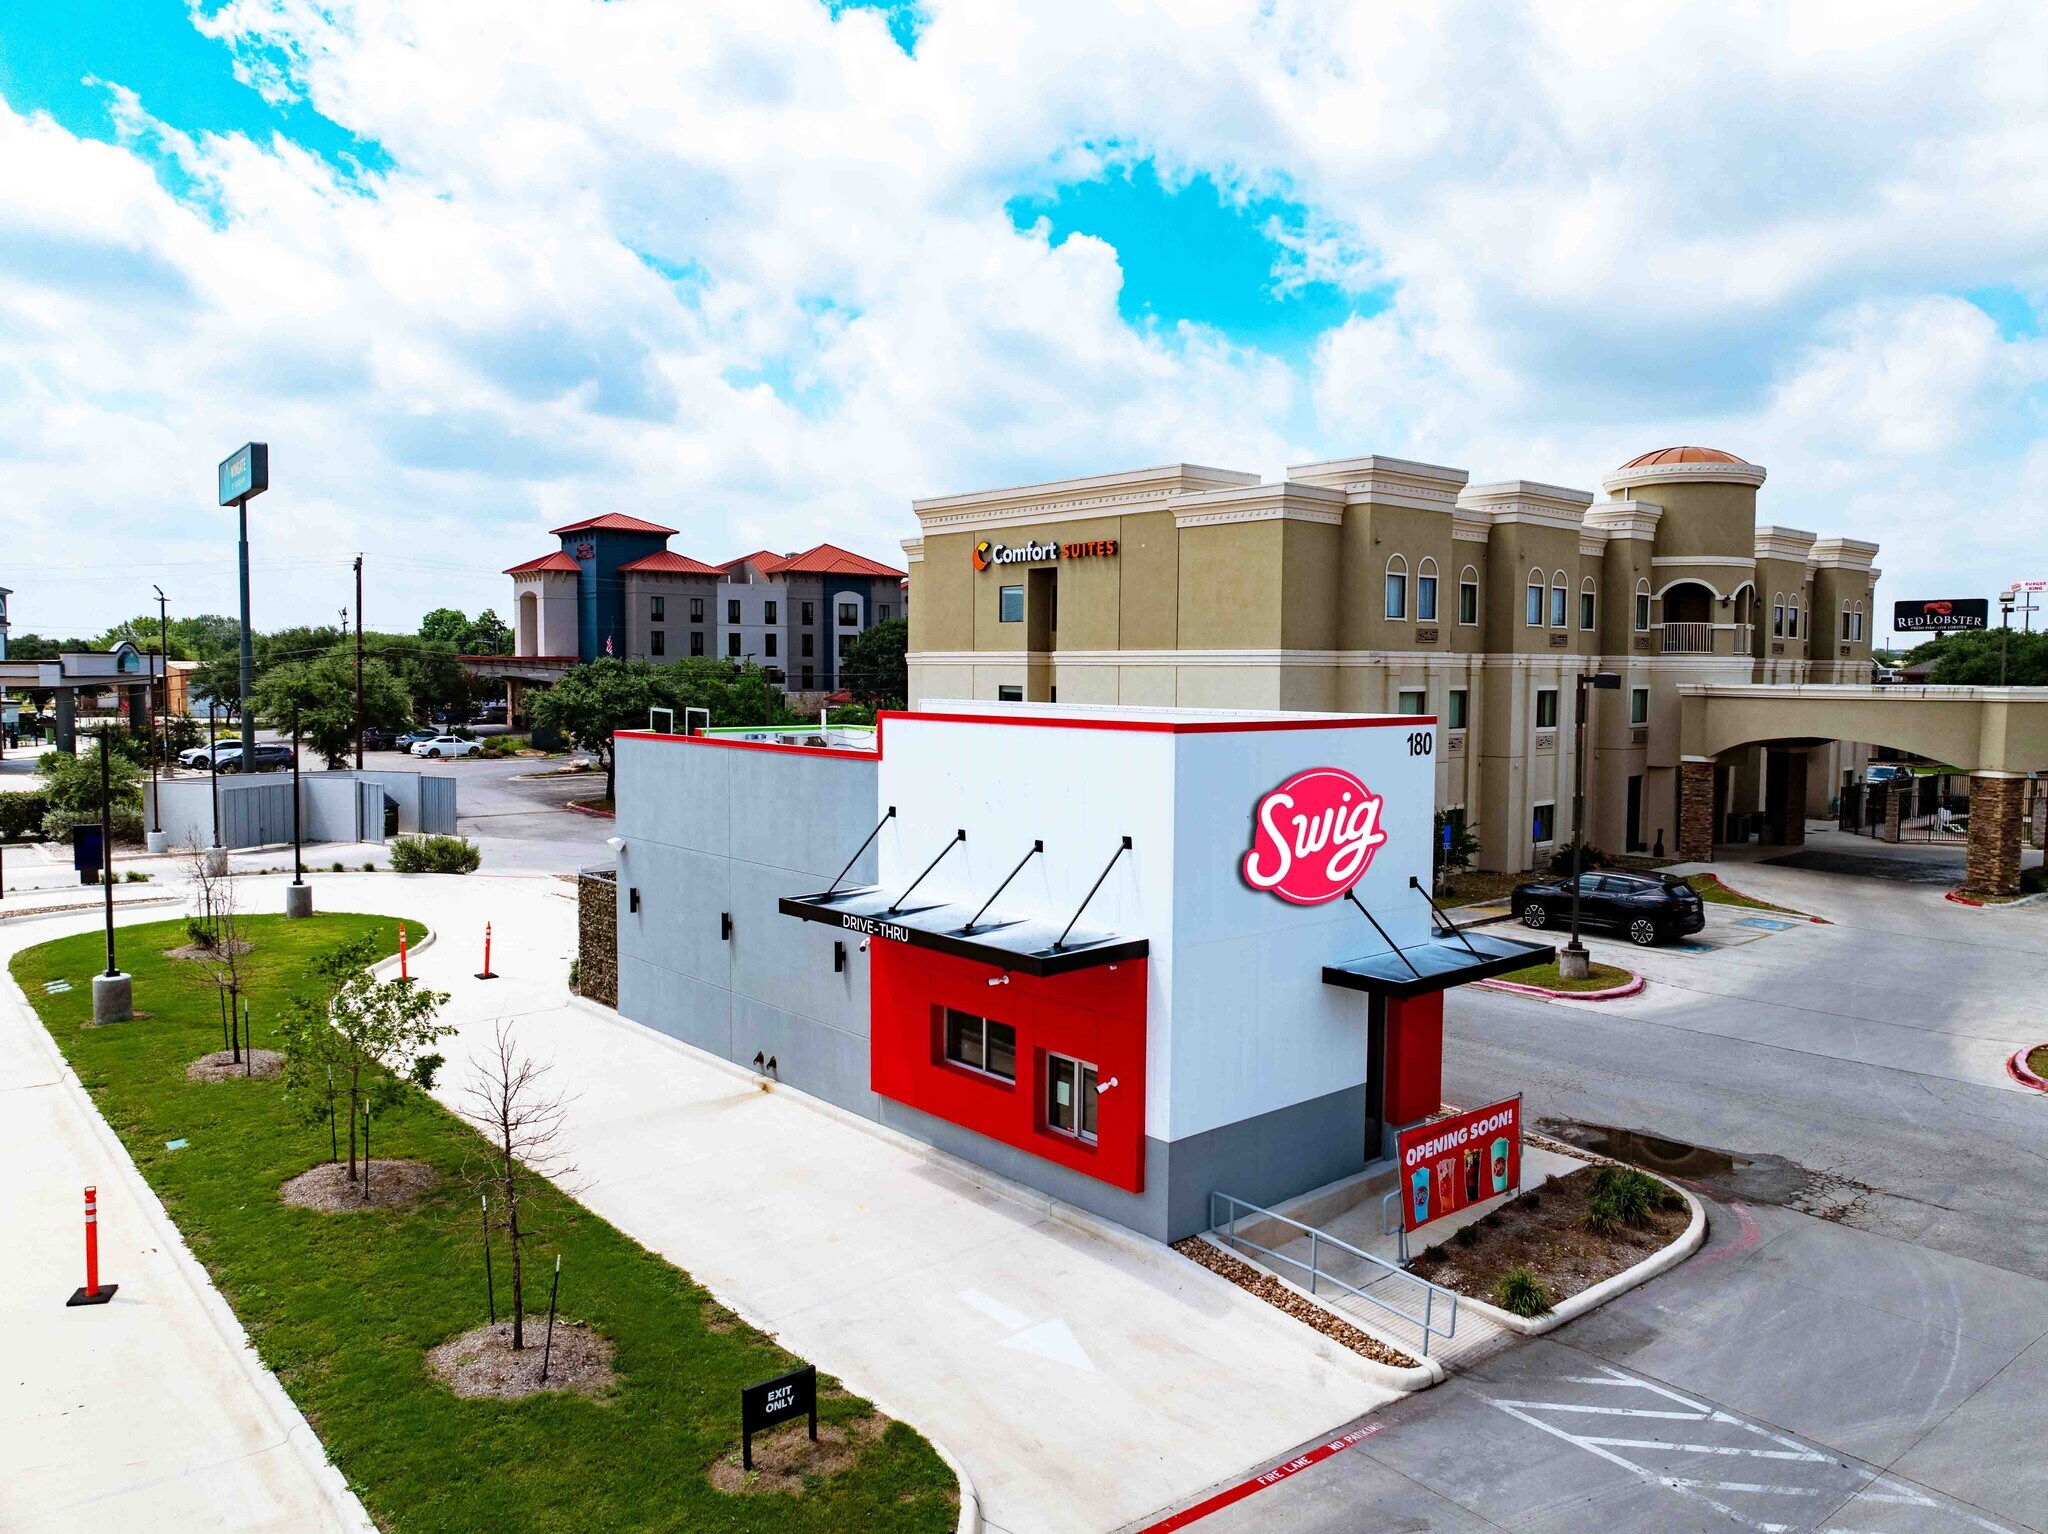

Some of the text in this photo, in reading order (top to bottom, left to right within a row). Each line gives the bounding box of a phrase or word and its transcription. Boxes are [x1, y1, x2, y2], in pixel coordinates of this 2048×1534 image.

[992, 538, 1116, 564] Comfort SUITES
[1897, 614, 1983, 628] RED LOBSTER
[1407, 731, 1432, 757] 180
[1246, 791, 1385, 887] Swig
[843, 914, 909, 942] DRIVE-THRU
[1405, 1127, 1469, 1167] OPENING
[1469, 1108, 1513, 1140] SOON!
[765, 1395, 795, 1413] ONLY
[767, 1385, 793, 1402] EXIT
[1256, 1469, 1285, 1486] FIRE
[1282, 1455, 1313, 1473] LANE
[1327, 1441, 1345, 1452] NO
